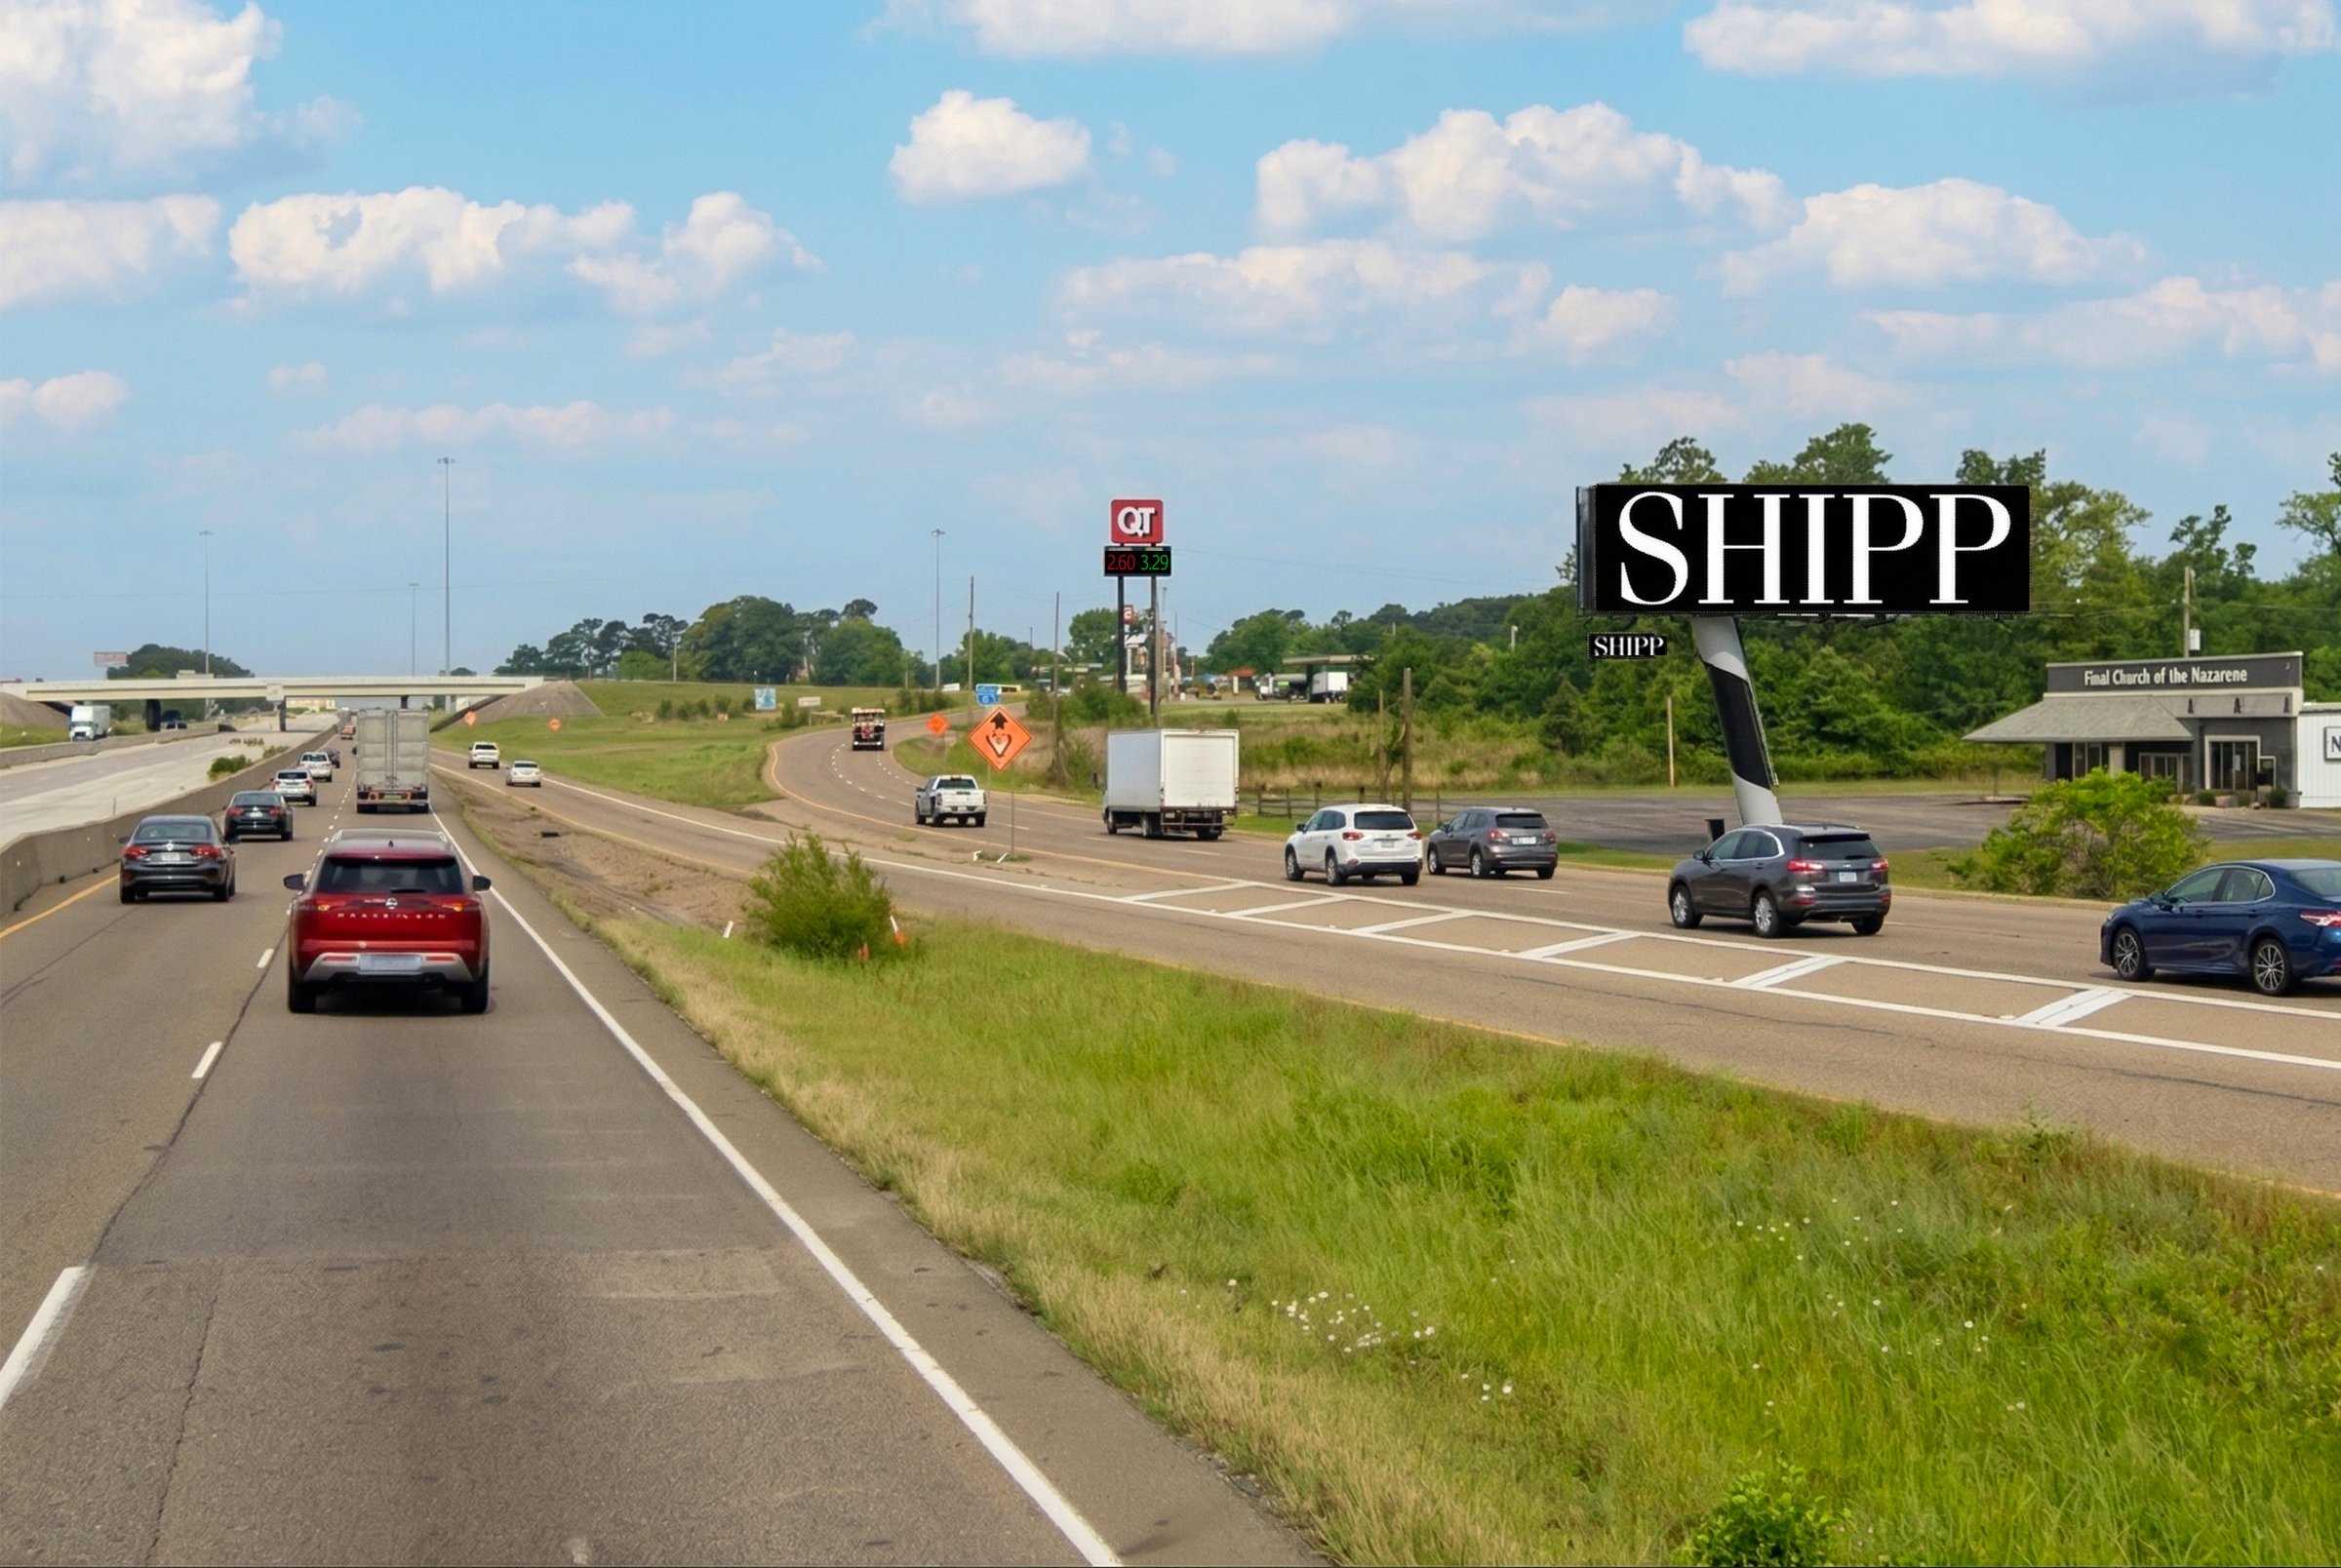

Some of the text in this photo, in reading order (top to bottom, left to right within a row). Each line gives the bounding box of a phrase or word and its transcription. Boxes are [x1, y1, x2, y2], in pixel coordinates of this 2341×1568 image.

[1117, 506, 1156, 537] QT
[1618, 491, 2011, 606] SHIPP
[1107, 554, 1170, 570] 2.60 3.29
[1594, 636, 1664, 656] SHIPP
[2112, 668, 2151, 686] Church
[2153, 666, 2166, 685] of
[2168, 667, 2188, 684] the
[2191, 666, 2247, 683] Nazarene
